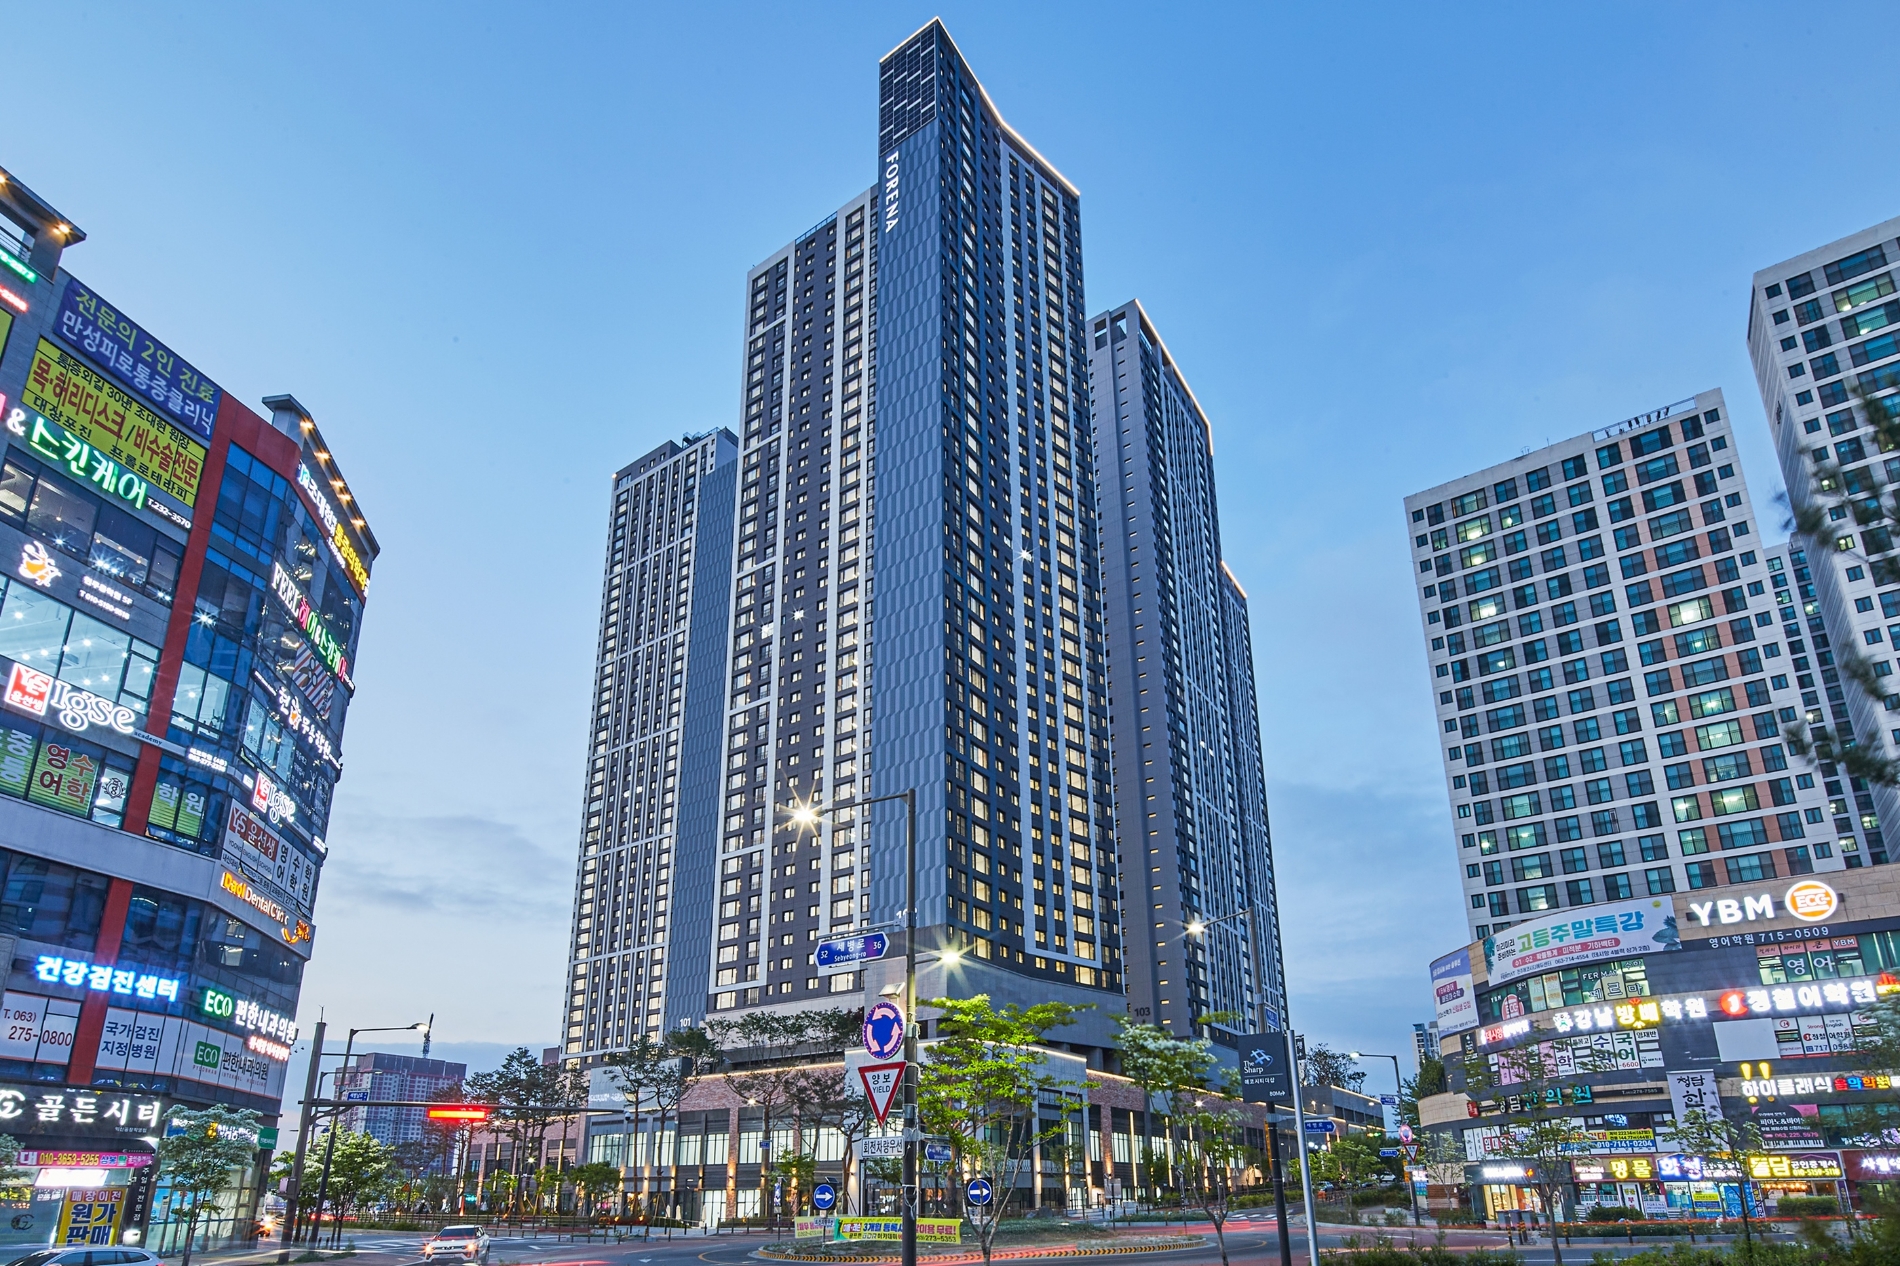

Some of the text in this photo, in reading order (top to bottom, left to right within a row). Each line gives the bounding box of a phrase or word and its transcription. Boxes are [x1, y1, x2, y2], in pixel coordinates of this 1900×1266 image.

[886, 150, 899, 233] FORENA
[75, 288, 215, 404] 전문의 2인 진료
[62, 310, 214, 436] 만성피로통증클리닉
[29, 415, 148, 510] 스킨케어
[271, 560, 303, 618] FEEL
[39, 743, 71, 797] 영어
[66, 753, 95, 805] 수학
[157, 781, 206, 818] 학원
[247, 823, 276, 859] 윤선생
[276, 843, 290, 885] 영어
[289, 855, 301, 894] 수학
[244, 885, 271, 918] Dental
[1689, 892, 1776, 927] YBM
[1516, 910, 1645, 954] 고등주말특강
[1708, 926, 1830, 949] 영어학원 715-0509
[1833, 937, 1855, 947] YBM
[820, 950, 829, 960] 32
[836, 937, 866, 952] 세병로
[872, 940, 882, 951] 36
[834, 951, 867, 963] Sebyeong-ro
[1786, 955, 1834, 976] 영어
[35, 955, 180, 1003] 건강검진센터
[1747, 979, 1877, 1013] 정철어학원
[13, 1011, 37, 1023] 063)
[204, 989, 298, 1046] ECO 편한내과의원
[1134, 1007, 1151, 1017] 103
[1573, 997, 1708, 1031] 강남방배학원
[8, 1025, 73, 1047] 275-0800
[105, 1020, 161, 1042] 국가 검진
[1825, 1021, 1844, 1029] English
[101, 1040, 157, 1060] 지정 병원
[1615, 1032, 1636, 1061] 국어
[196, 1045, 269, 1081] ECO 편한내과의원
[1243, 1067, 1264, 1075] Sharp
[871, 1072, 892, 1085] 양보
[872, 1084, 892, 1094] YIELD
[1740, 1074, 1891, 1098] 하이클래식 음악학원
[35, 1094, 161, 1128] 골든시티
[863, 1138, 903, 1156] 회전차량우선
[1609, 1159, 1652, 1180] 명물
[1790, 1160, 1838, 1169] 공인중개사
[70, 1189, 123, 1203] 매장이전
[70, 1202, 118, 1226] 원가
[66, 1225, 113, 1247] 판매
